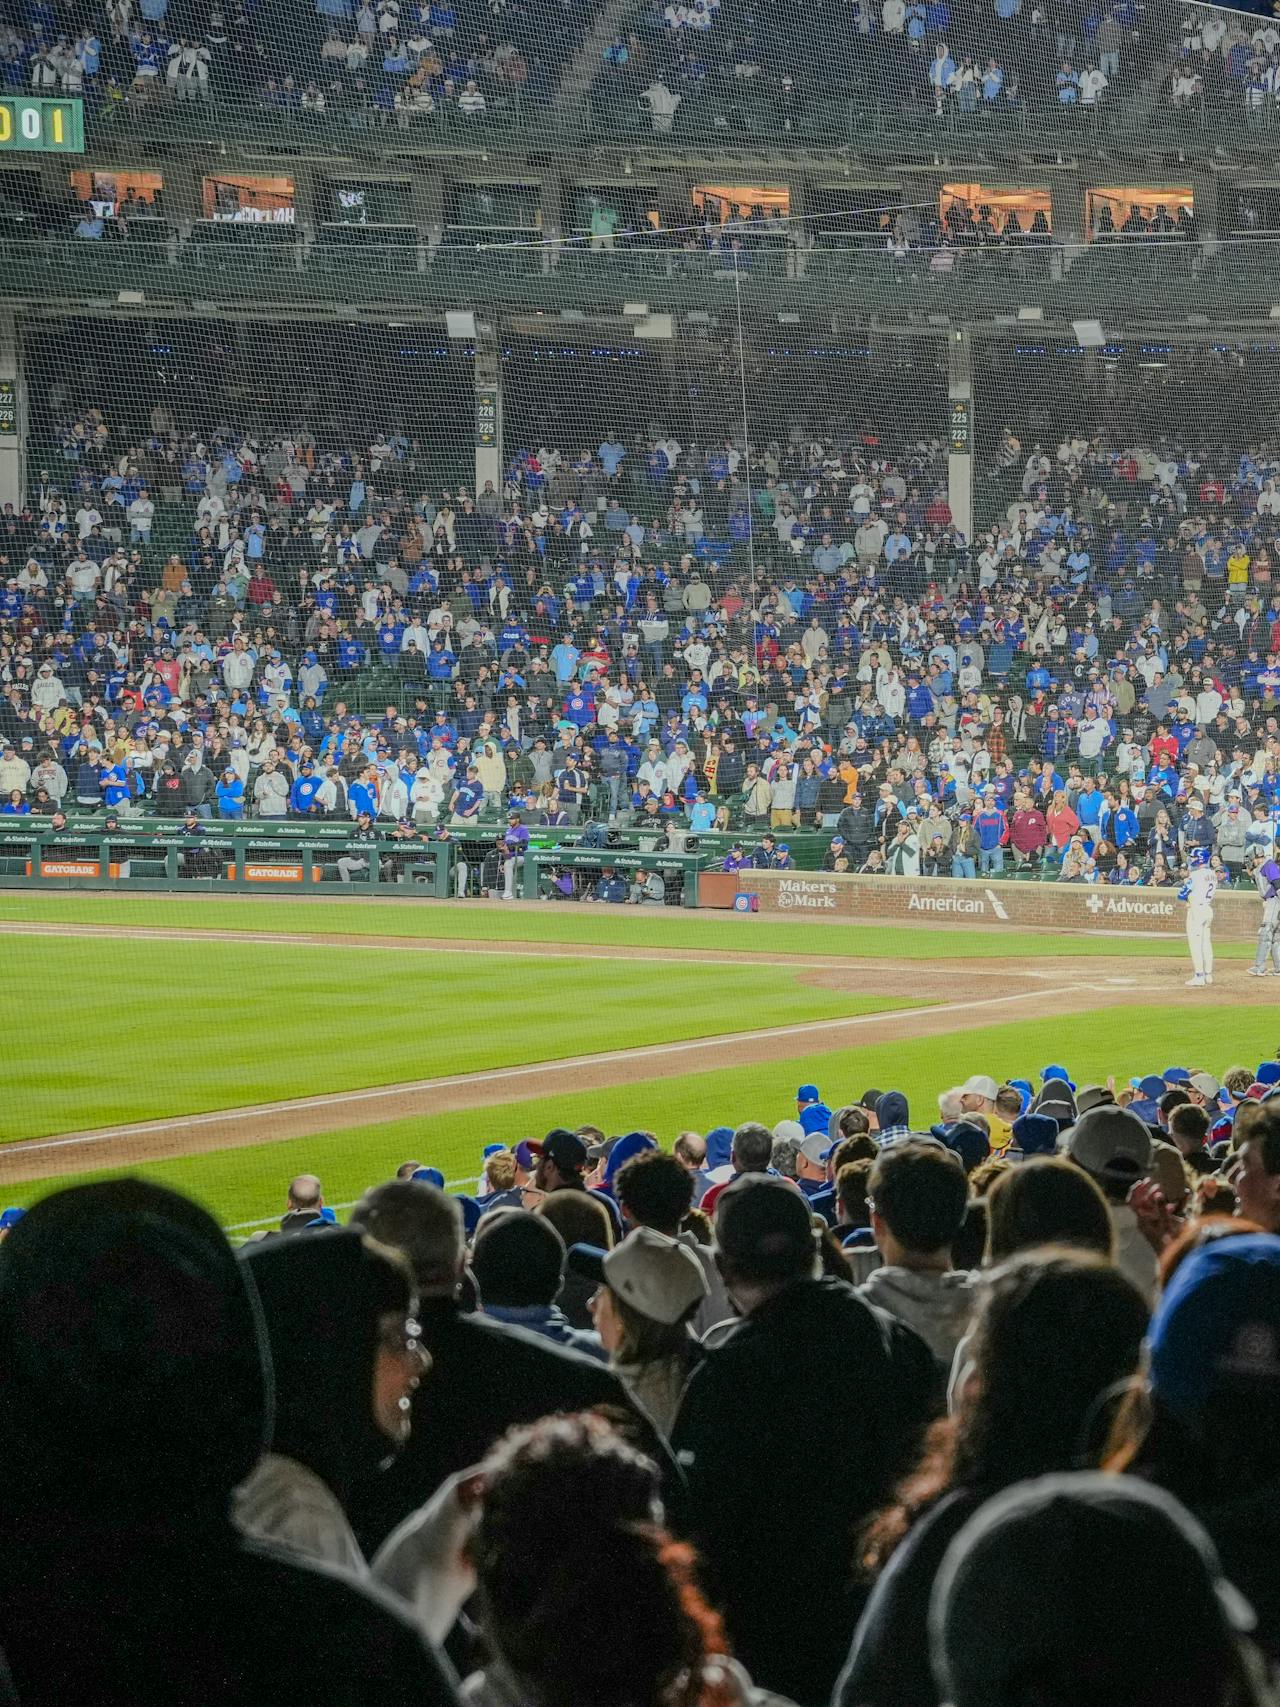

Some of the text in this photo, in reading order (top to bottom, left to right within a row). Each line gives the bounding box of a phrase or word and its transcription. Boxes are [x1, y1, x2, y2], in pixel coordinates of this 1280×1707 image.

[22, 108, 40, 139] 0
[53, 109, 63, 143] 1
[478, 406, 494, 417] 226
[952, 413, 967, 423] 225
[478, 423, 494, 433] 225
[952, 430, 967, 440] 223
[44, 864, 96, 875] GATORADE
[248, 869, 299, 878] GATORADE
[778, 879, 837, 893] Maker's
[1206, 883, 1214, 899] 2
[793, 894, 837, 908] Mark
[908, 893, 985, 914] American
[1106, 897, 1174, 915] Advocate
